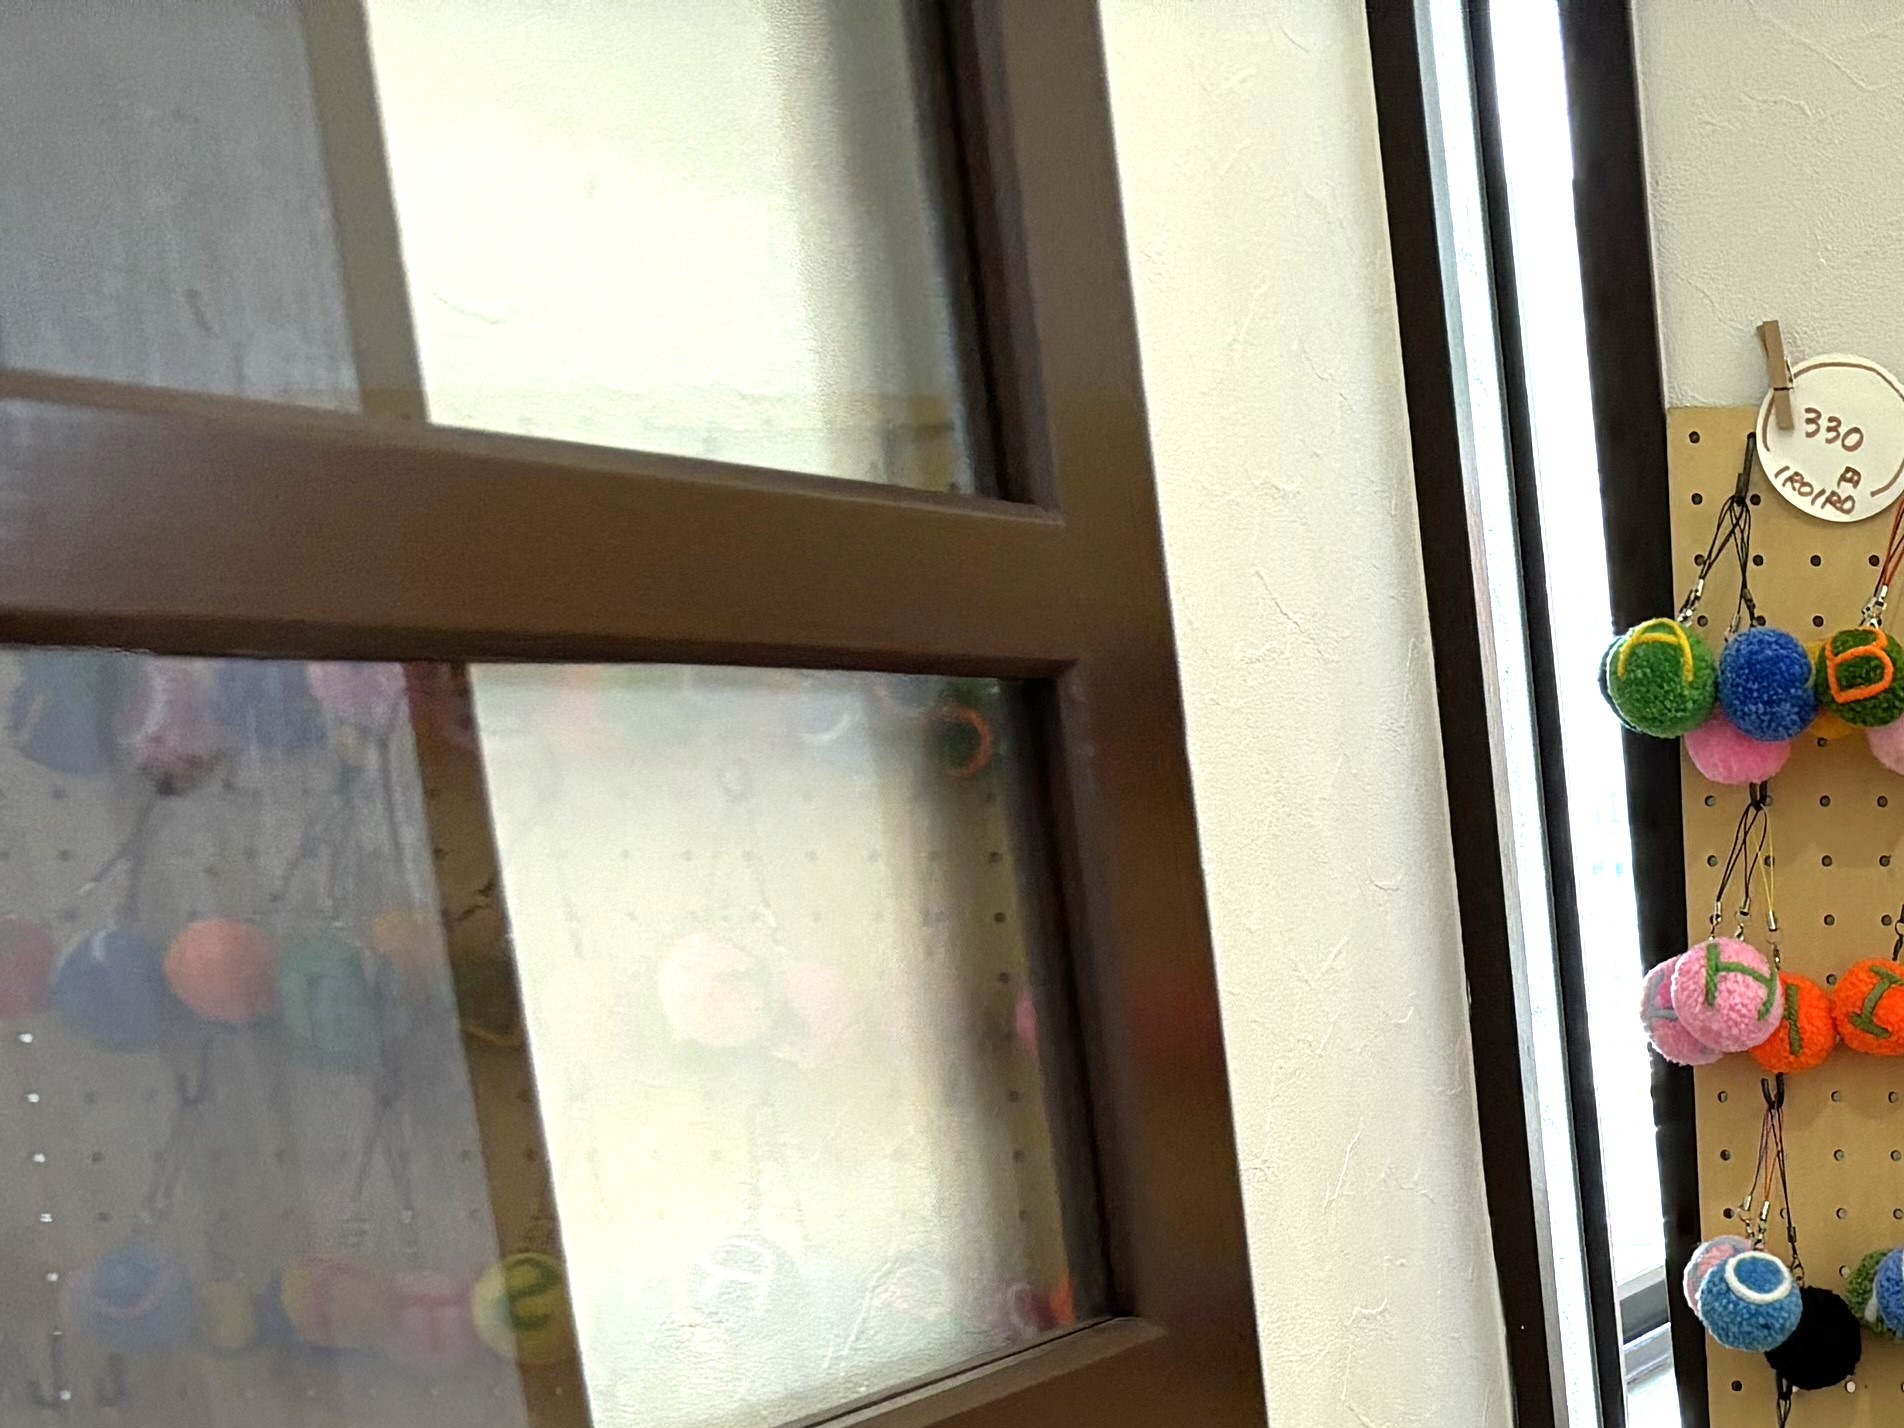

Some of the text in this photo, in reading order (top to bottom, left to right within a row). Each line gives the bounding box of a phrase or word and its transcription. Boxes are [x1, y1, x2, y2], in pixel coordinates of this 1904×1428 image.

[1804, 407, 1864, 452] 330
[1825, 626, 1894, 704] B
[1706, 943, 1777, 1022] H
